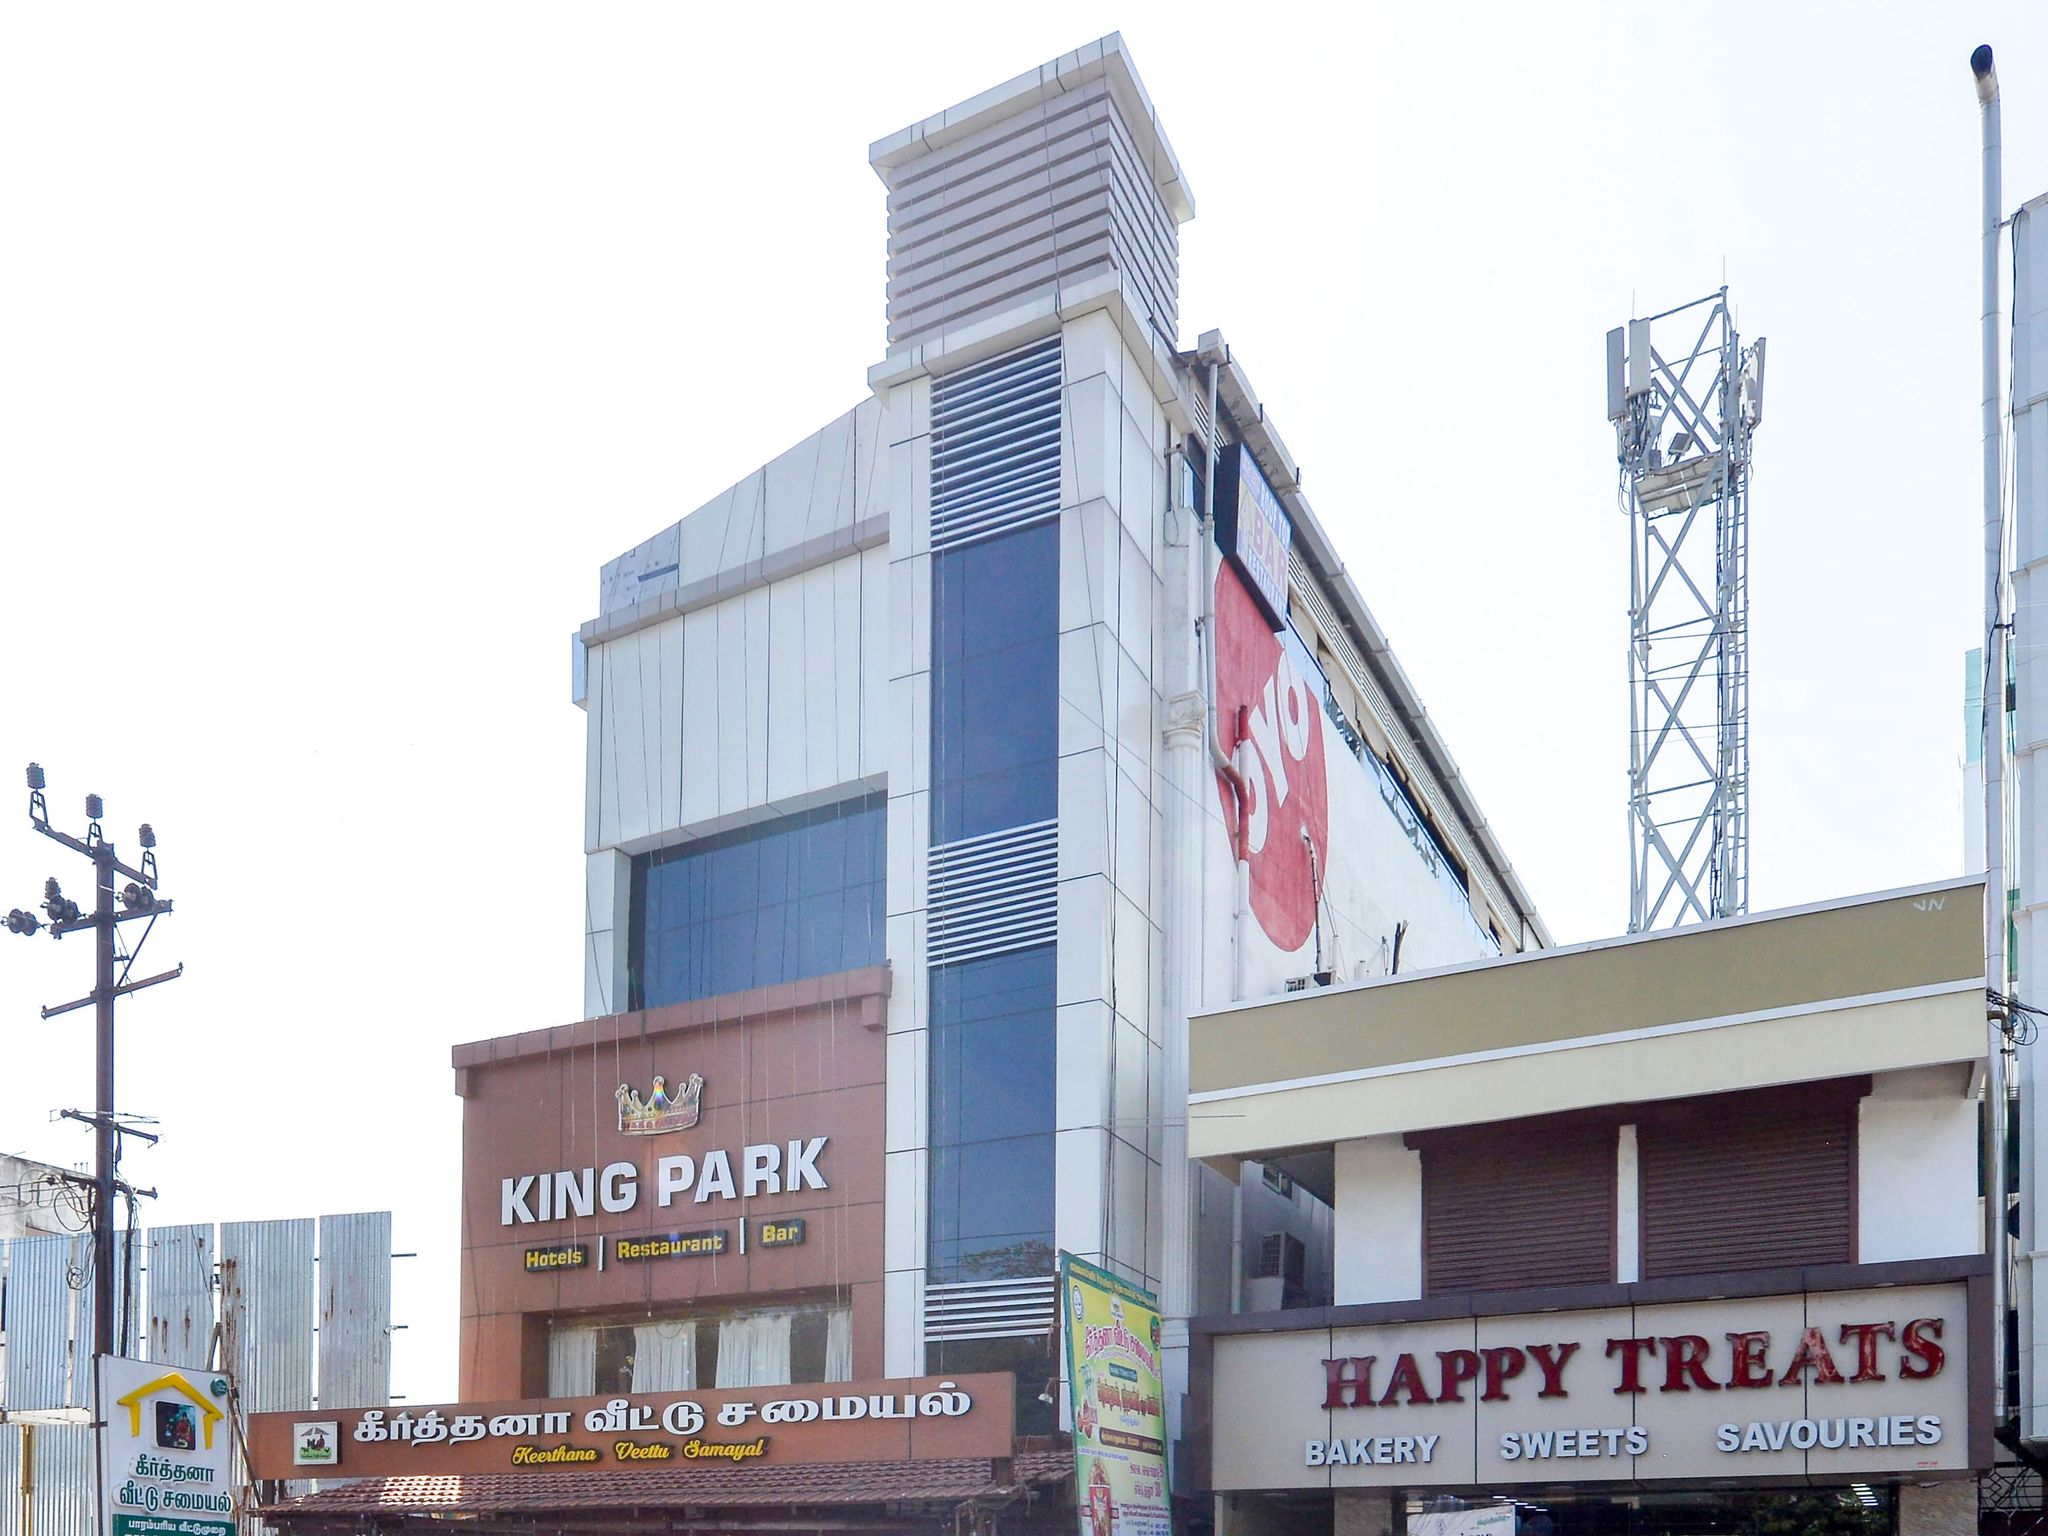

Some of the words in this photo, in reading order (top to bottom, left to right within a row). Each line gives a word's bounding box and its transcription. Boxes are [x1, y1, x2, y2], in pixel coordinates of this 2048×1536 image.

[1254, 507, 1287, 596] BAR
[1231, 650, 1310, 854] OYO
[501, 1161, 638, 1226] KING
[658, 1136, 829, 1208] PARK
[526, 1249, 583, 1269] Hotels
[617, 1234, 723, 1260] Restaurant
[762, 1223, 799, 1244] Bar
[1320, 1341, 1581, 1410] HAPPY
[1604, 1316, 1946, 1395] TREATS
[352, 1409, 572, 1448] கீர்த்தனா
[583, 1398, 706, 1436] வீட்டு
[716, 1380, 973, 1427] சமையல்
[1305, 1435, 1440, 1467] BAKERY
[1499, 1425, 1649, 1461] SWEETS
[1716, 1413, 1943, 1454] SAVOURIES
[135, 1453, 215, 1483] கீர்த்தனா
[511, 1445, 598, 1466] Keerthana
[615, 1440, 670, 1461] Veettu
[683, 1438, 765, 1463] Samayal
[119, 1480, 159, 1512] வீட்டு
[162, 1490, 232, 1513] சமையல்
